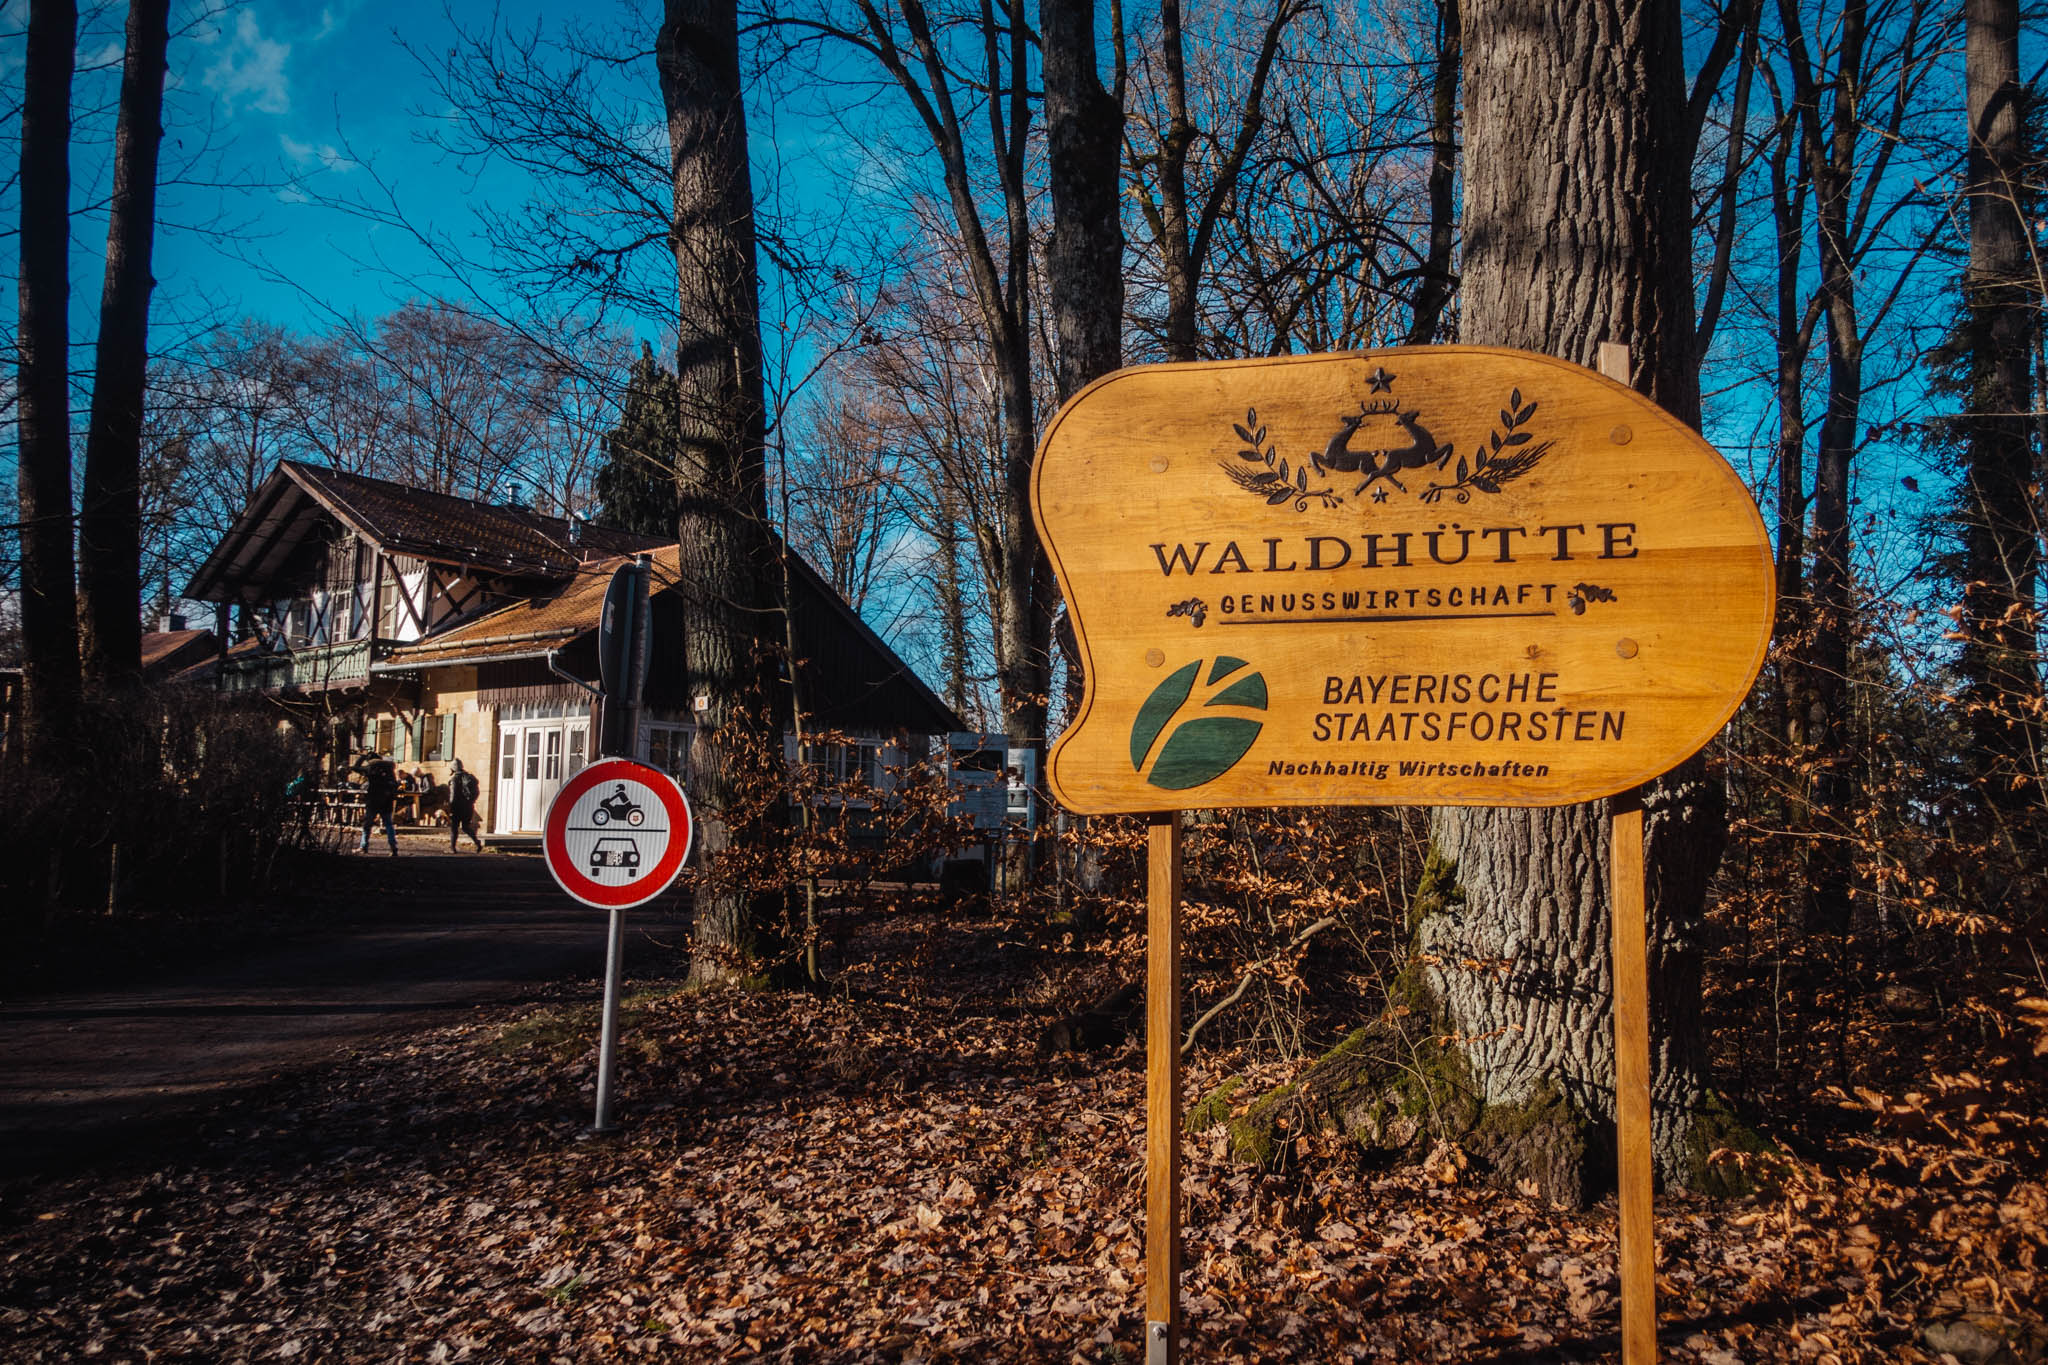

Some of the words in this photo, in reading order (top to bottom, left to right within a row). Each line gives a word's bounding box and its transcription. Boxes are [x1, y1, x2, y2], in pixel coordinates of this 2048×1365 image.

[1150, 522, 1639, 577] WALDHÜTTE
[1220, 583, 1557, 614] GENUSSWIRTSCHAFT
[1323, 673, 1559, 705] BAYERISCHE
[1312, 711, 1625, 742] STAATSFORSTEN
[1268, 760, 1390, 780] Nachhaltig
[1399, 760, 1549, 777] Wirtschaften
